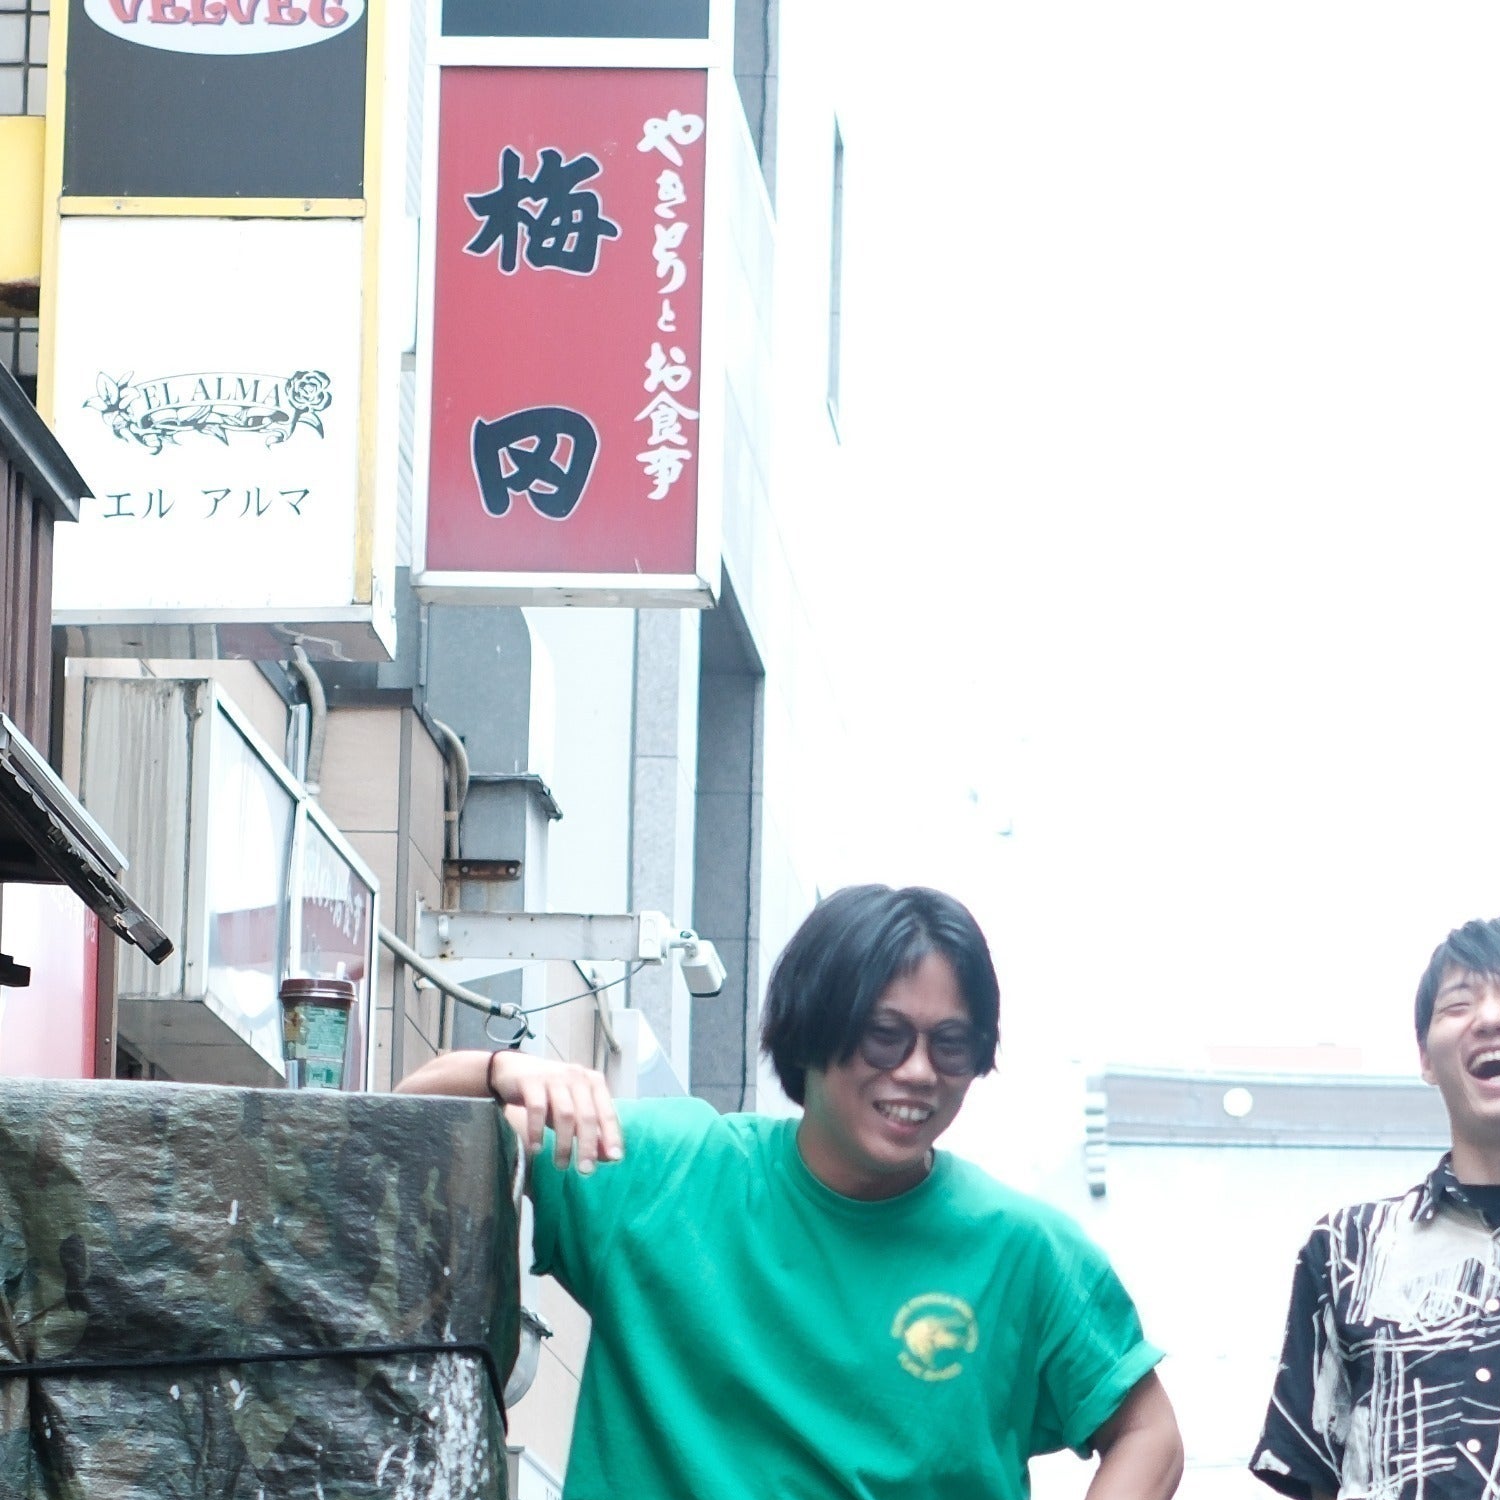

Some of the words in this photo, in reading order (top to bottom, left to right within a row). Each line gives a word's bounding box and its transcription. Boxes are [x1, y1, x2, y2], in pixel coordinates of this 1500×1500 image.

[635, 109, 704, 501] やきとりとお食事
[143, 382, 180, 411] EL
[191, 376, 282, 408] ALMA
[103, 487, 176, 519] エル
[201, 486, 311, 519] アルマ
